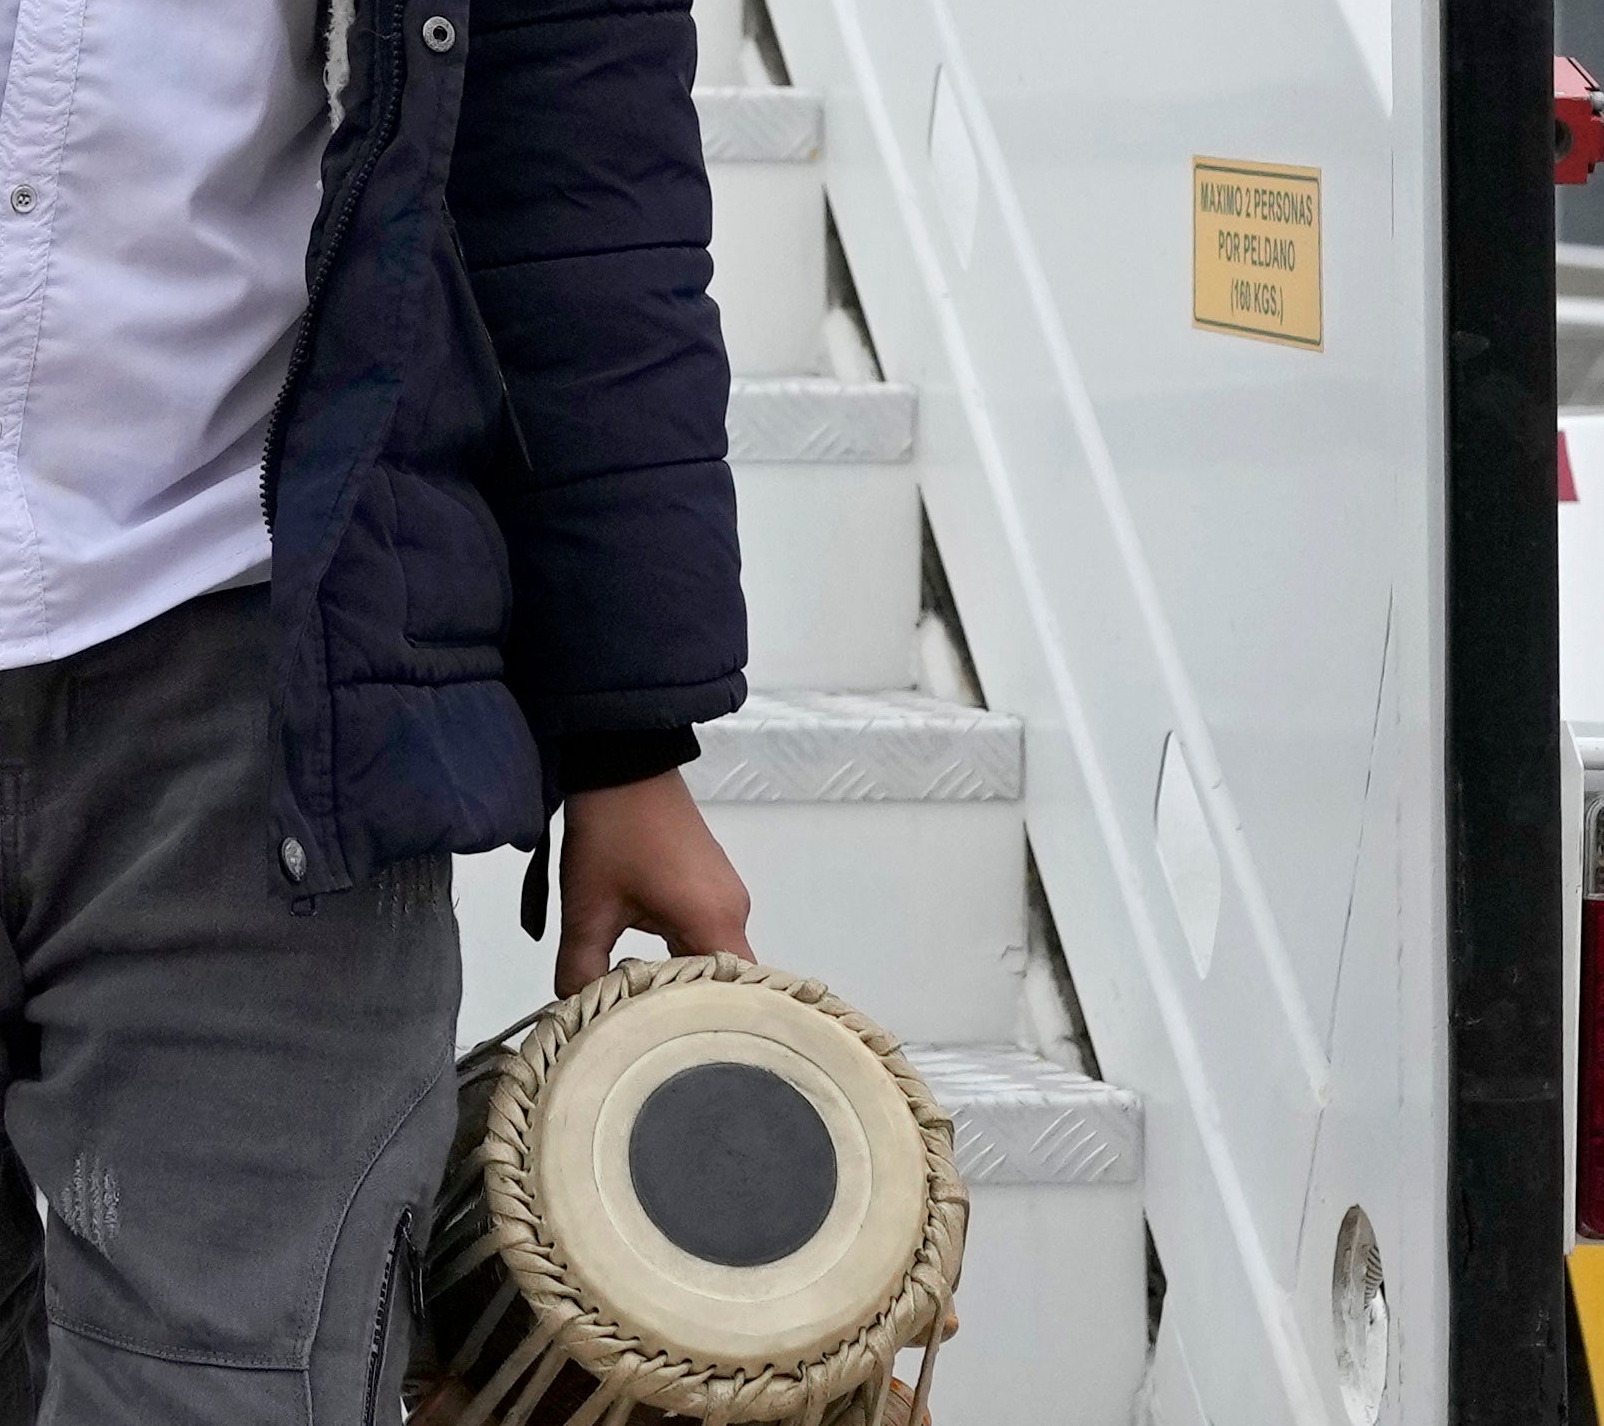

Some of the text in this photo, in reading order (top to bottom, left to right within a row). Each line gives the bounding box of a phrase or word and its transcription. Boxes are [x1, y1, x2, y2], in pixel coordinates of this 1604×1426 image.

[1201, 181, 1313, 227] MAXIMO 2 PERSONAS
[1218, 229, 1241, 263] POR
[1230, 278, 1284, 326] (160 KGS.)
